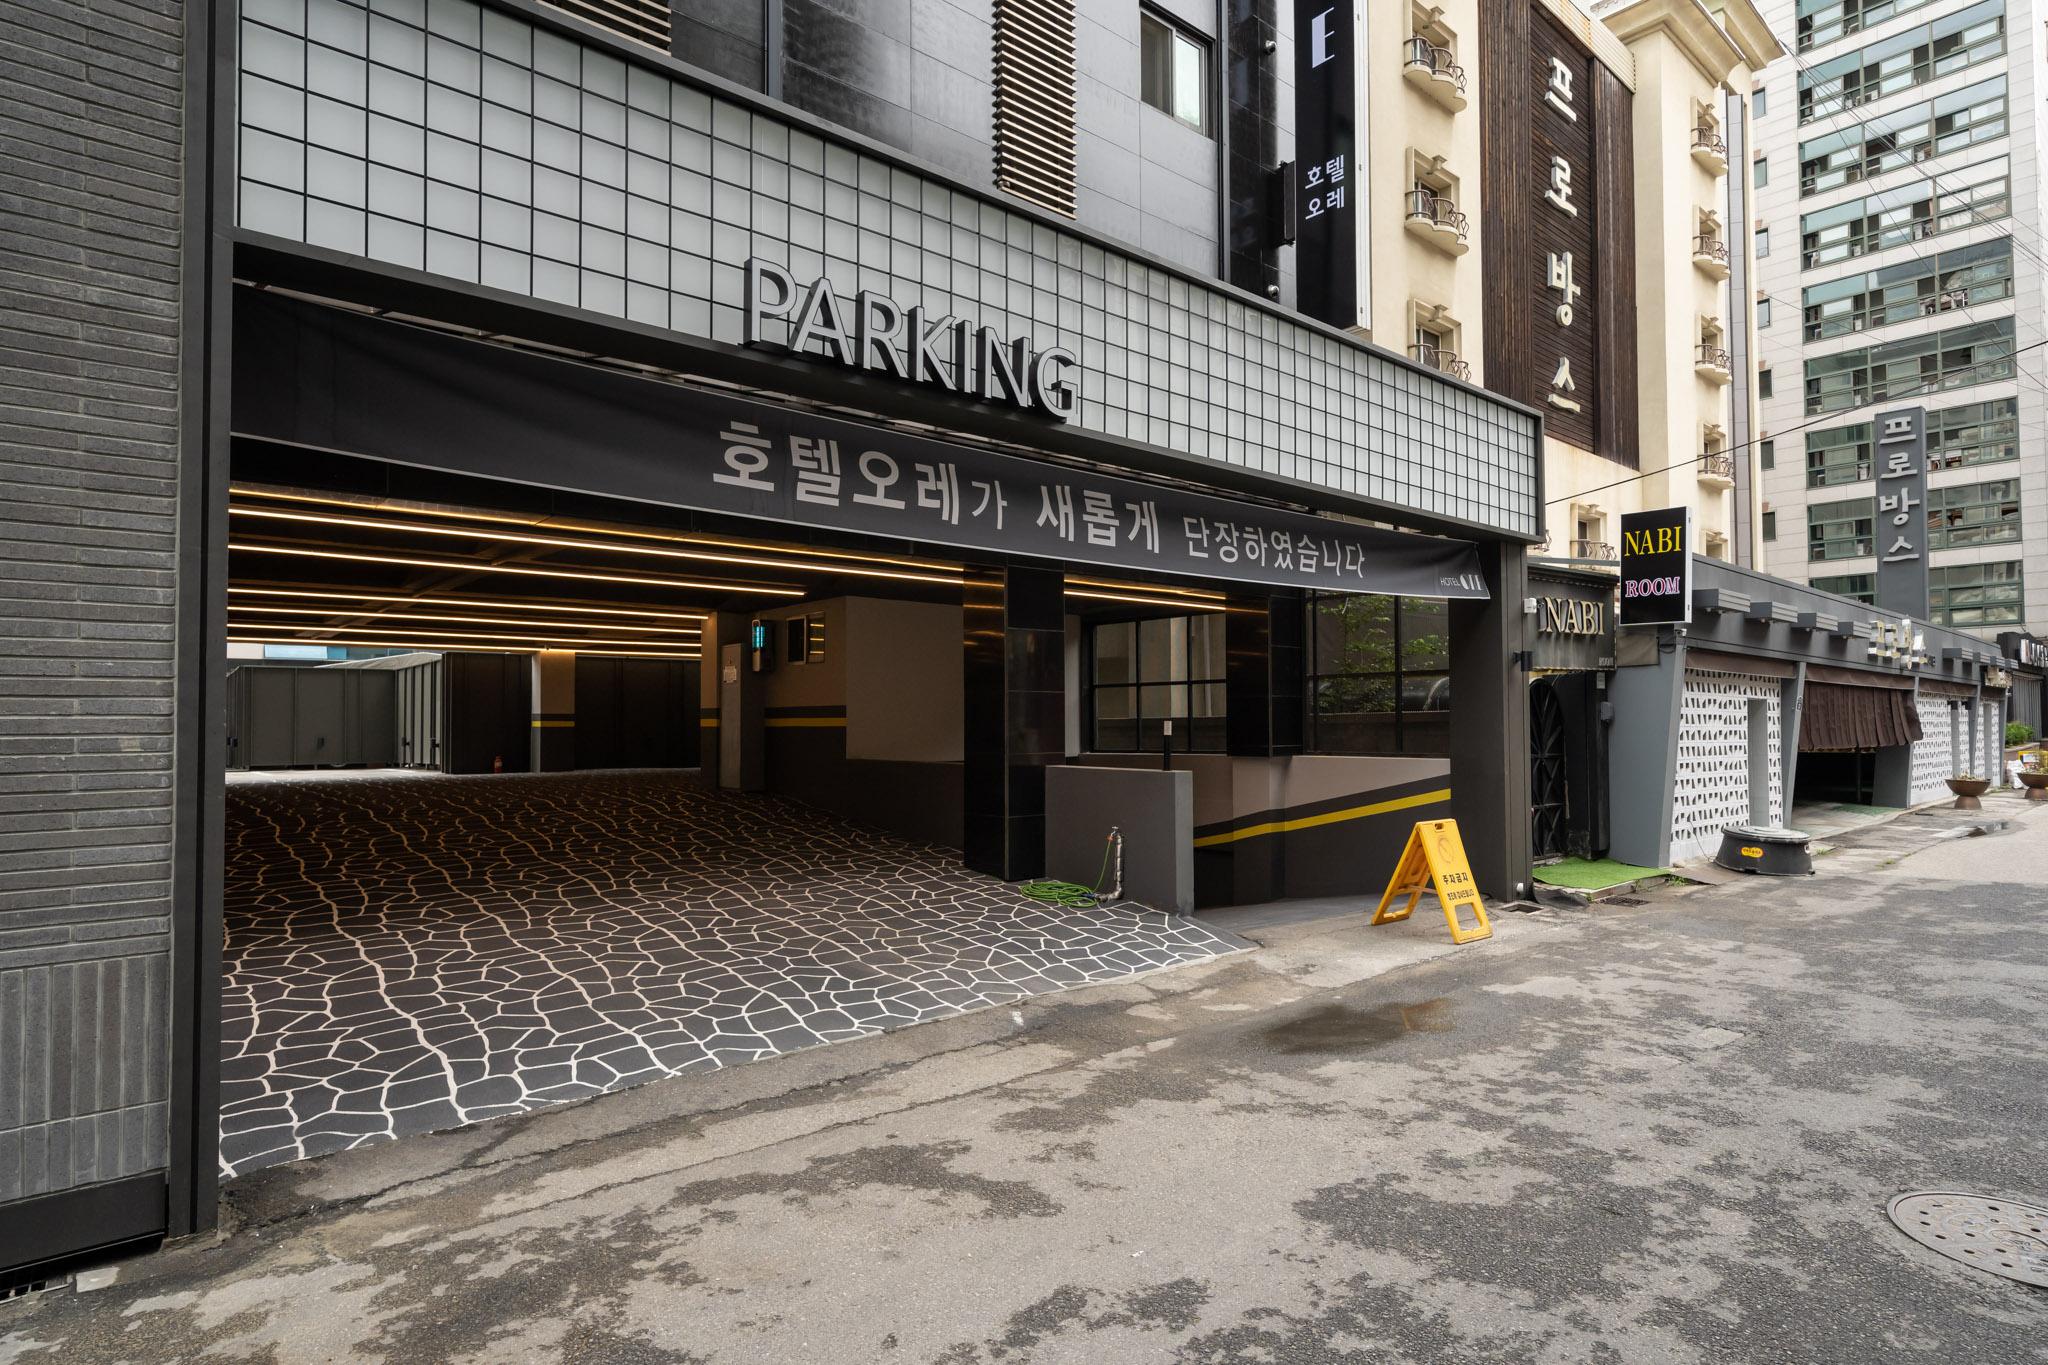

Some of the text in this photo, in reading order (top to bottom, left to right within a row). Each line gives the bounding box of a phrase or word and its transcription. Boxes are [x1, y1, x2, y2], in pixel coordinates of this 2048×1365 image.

[1304, 154, 1345, 190] 호텔
[1304, 185, 1345, 220] 오레
[1544, 56, 1580, 413] 프로방스
[743, 255, 1079, 423] PARKING
[712, 420, 1366, 579] 호텔오레가 새롭게 단장하였습니다
[1879, 415, 1921, 563] 프로방스
[1623, 525, 1683, 557] NABI
[1440, 576, 1461, 587] HOTEL
[1624, 576, 1681, 599] ROOM
[1541, 596, 1605, 636] NABI
[1442, 872, 1468, 884] 주차금지
